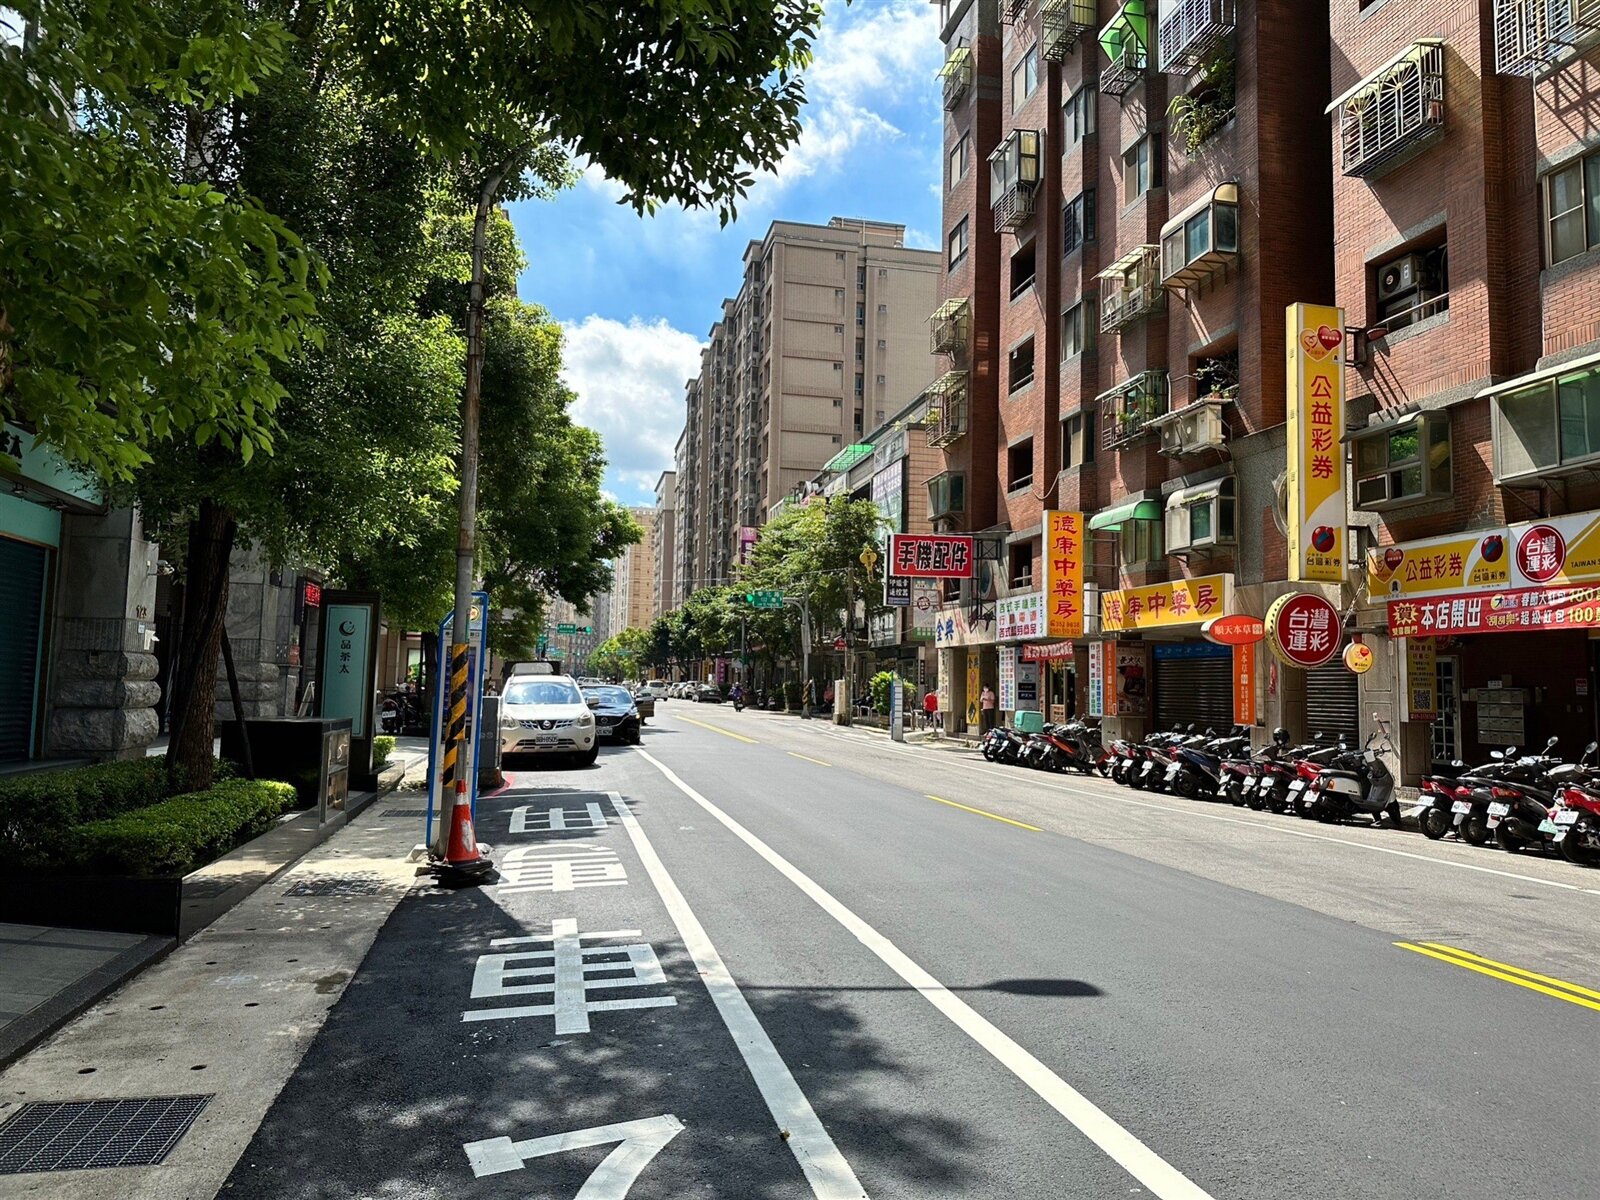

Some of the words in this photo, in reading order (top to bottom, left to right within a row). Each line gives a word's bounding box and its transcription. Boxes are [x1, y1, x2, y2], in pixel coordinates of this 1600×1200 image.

[1310, 375, 1334, 480] 公益彩券
[898, 540, 968, 571] 手機配件
[1526, 535, 1557, 556] 台灣
[1053, 515, 1077, 619] 德康中藥房
[1405, 551, 1462, 583] 公益彩券
[1526, 553, 1558, 573] 運彩
[1571, 559, 1596, 568] TAIWAN
[1107, 585, 1218, 622] 德康中藥房
[1397, 606, 1413, 621] 賀
[1420, 598, 1482, 631] 本店開出
[936, 616, 954, 641] 金典
[1288, 607, 1330, 630] 台灣
[1287, 630, 1330, 652] 運彩
